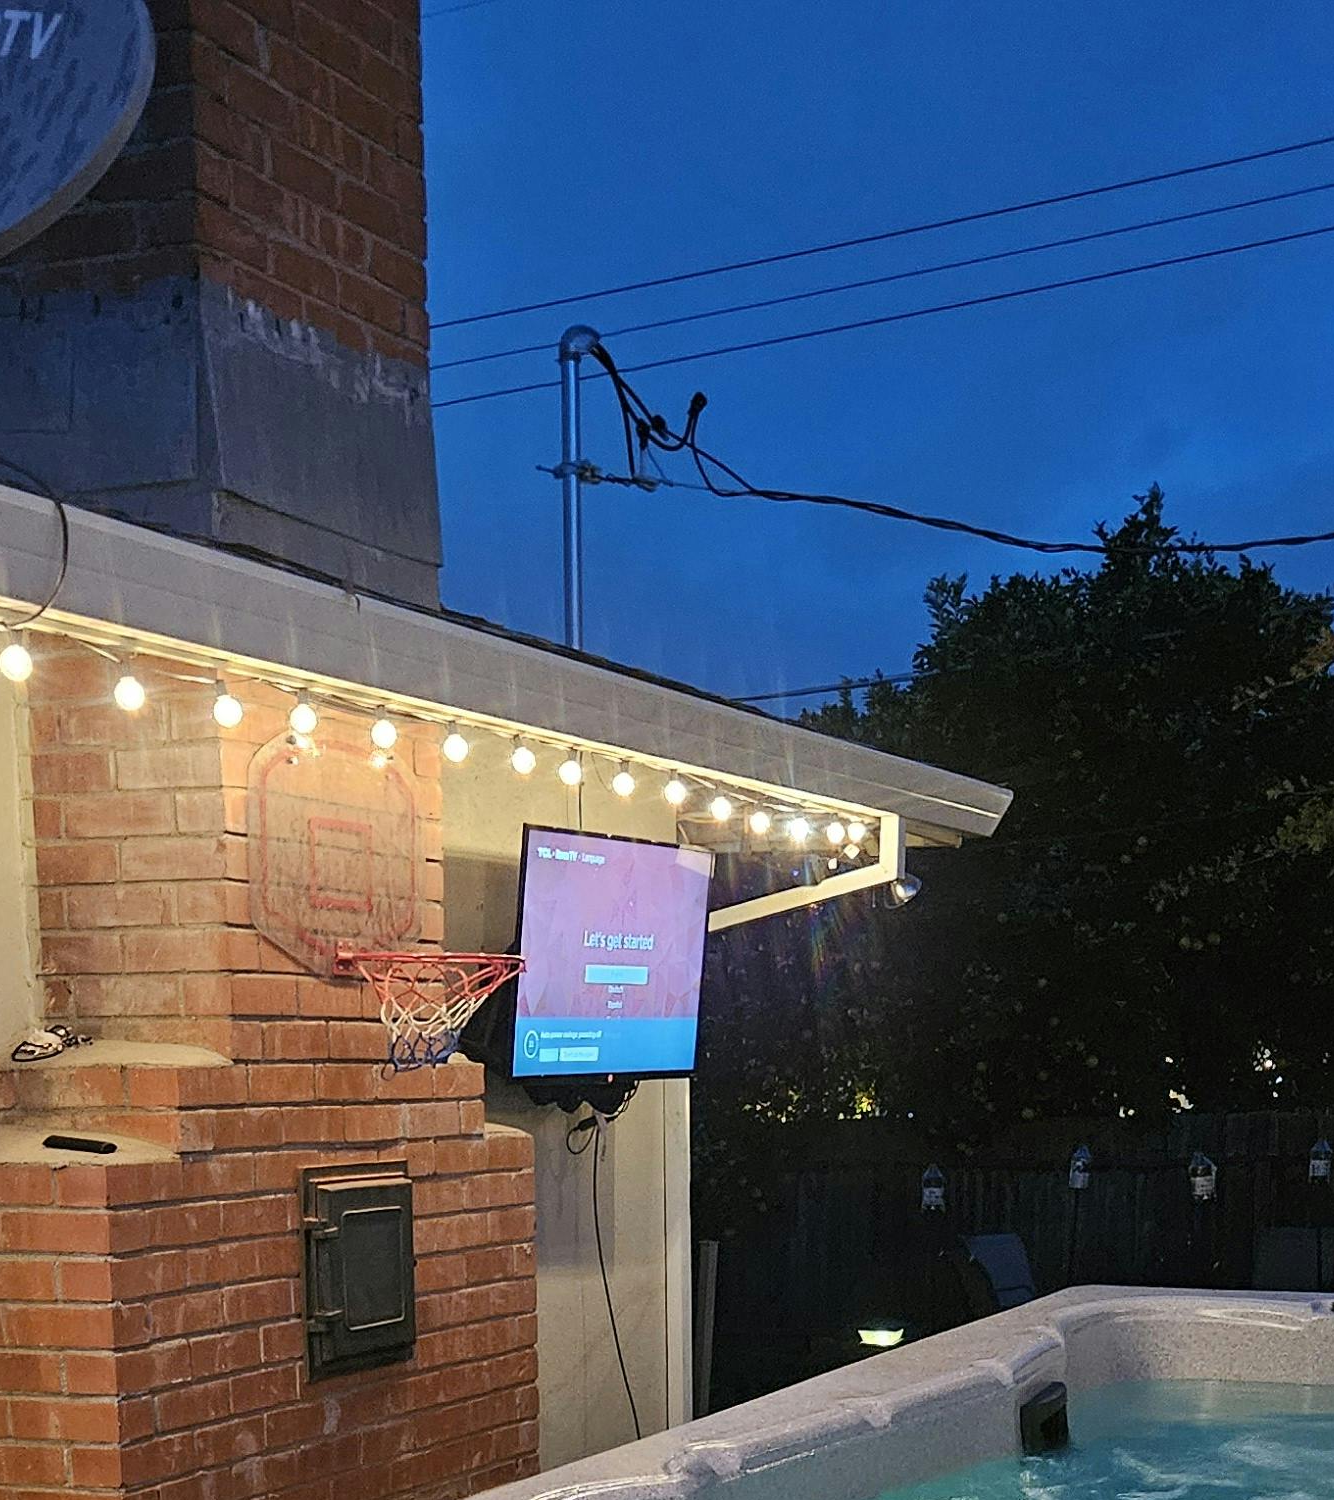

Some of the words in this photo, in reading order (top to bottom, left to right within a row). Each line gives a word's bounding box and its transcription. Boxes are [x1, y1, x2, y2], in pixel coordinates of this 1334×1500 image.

[583, 929, 606, 948] Let's
[606, 932, 623, 951] get
[623, 932, 655, 951] started
